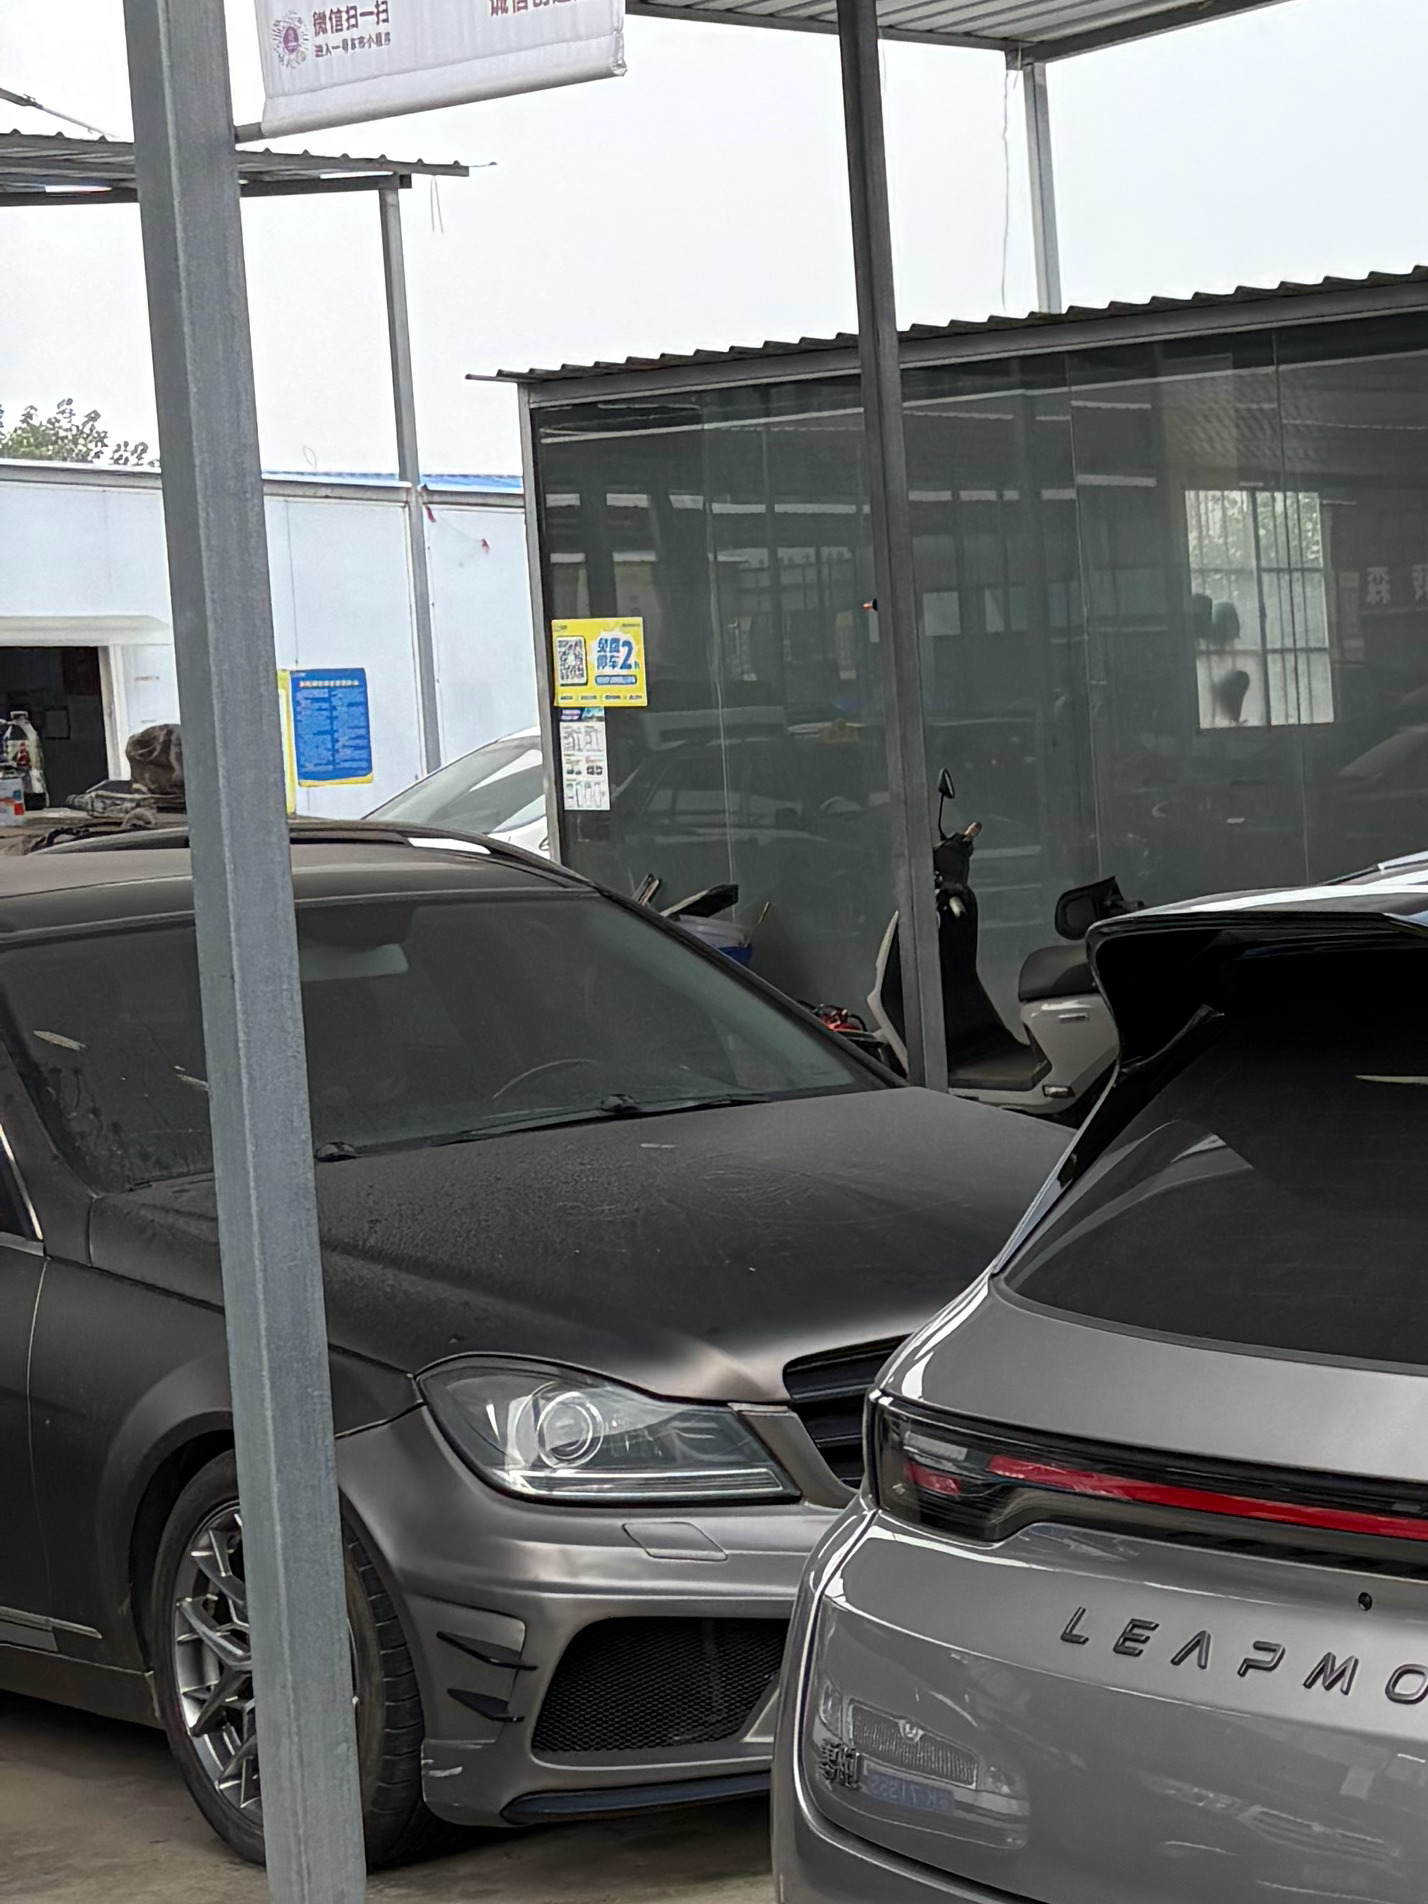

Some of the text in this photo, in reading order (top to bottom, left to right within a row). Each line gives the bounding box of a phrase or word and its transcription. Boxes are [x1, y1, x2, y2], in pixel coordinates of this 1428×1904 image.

[312, 0, 390, 37] 微信扫一扫
